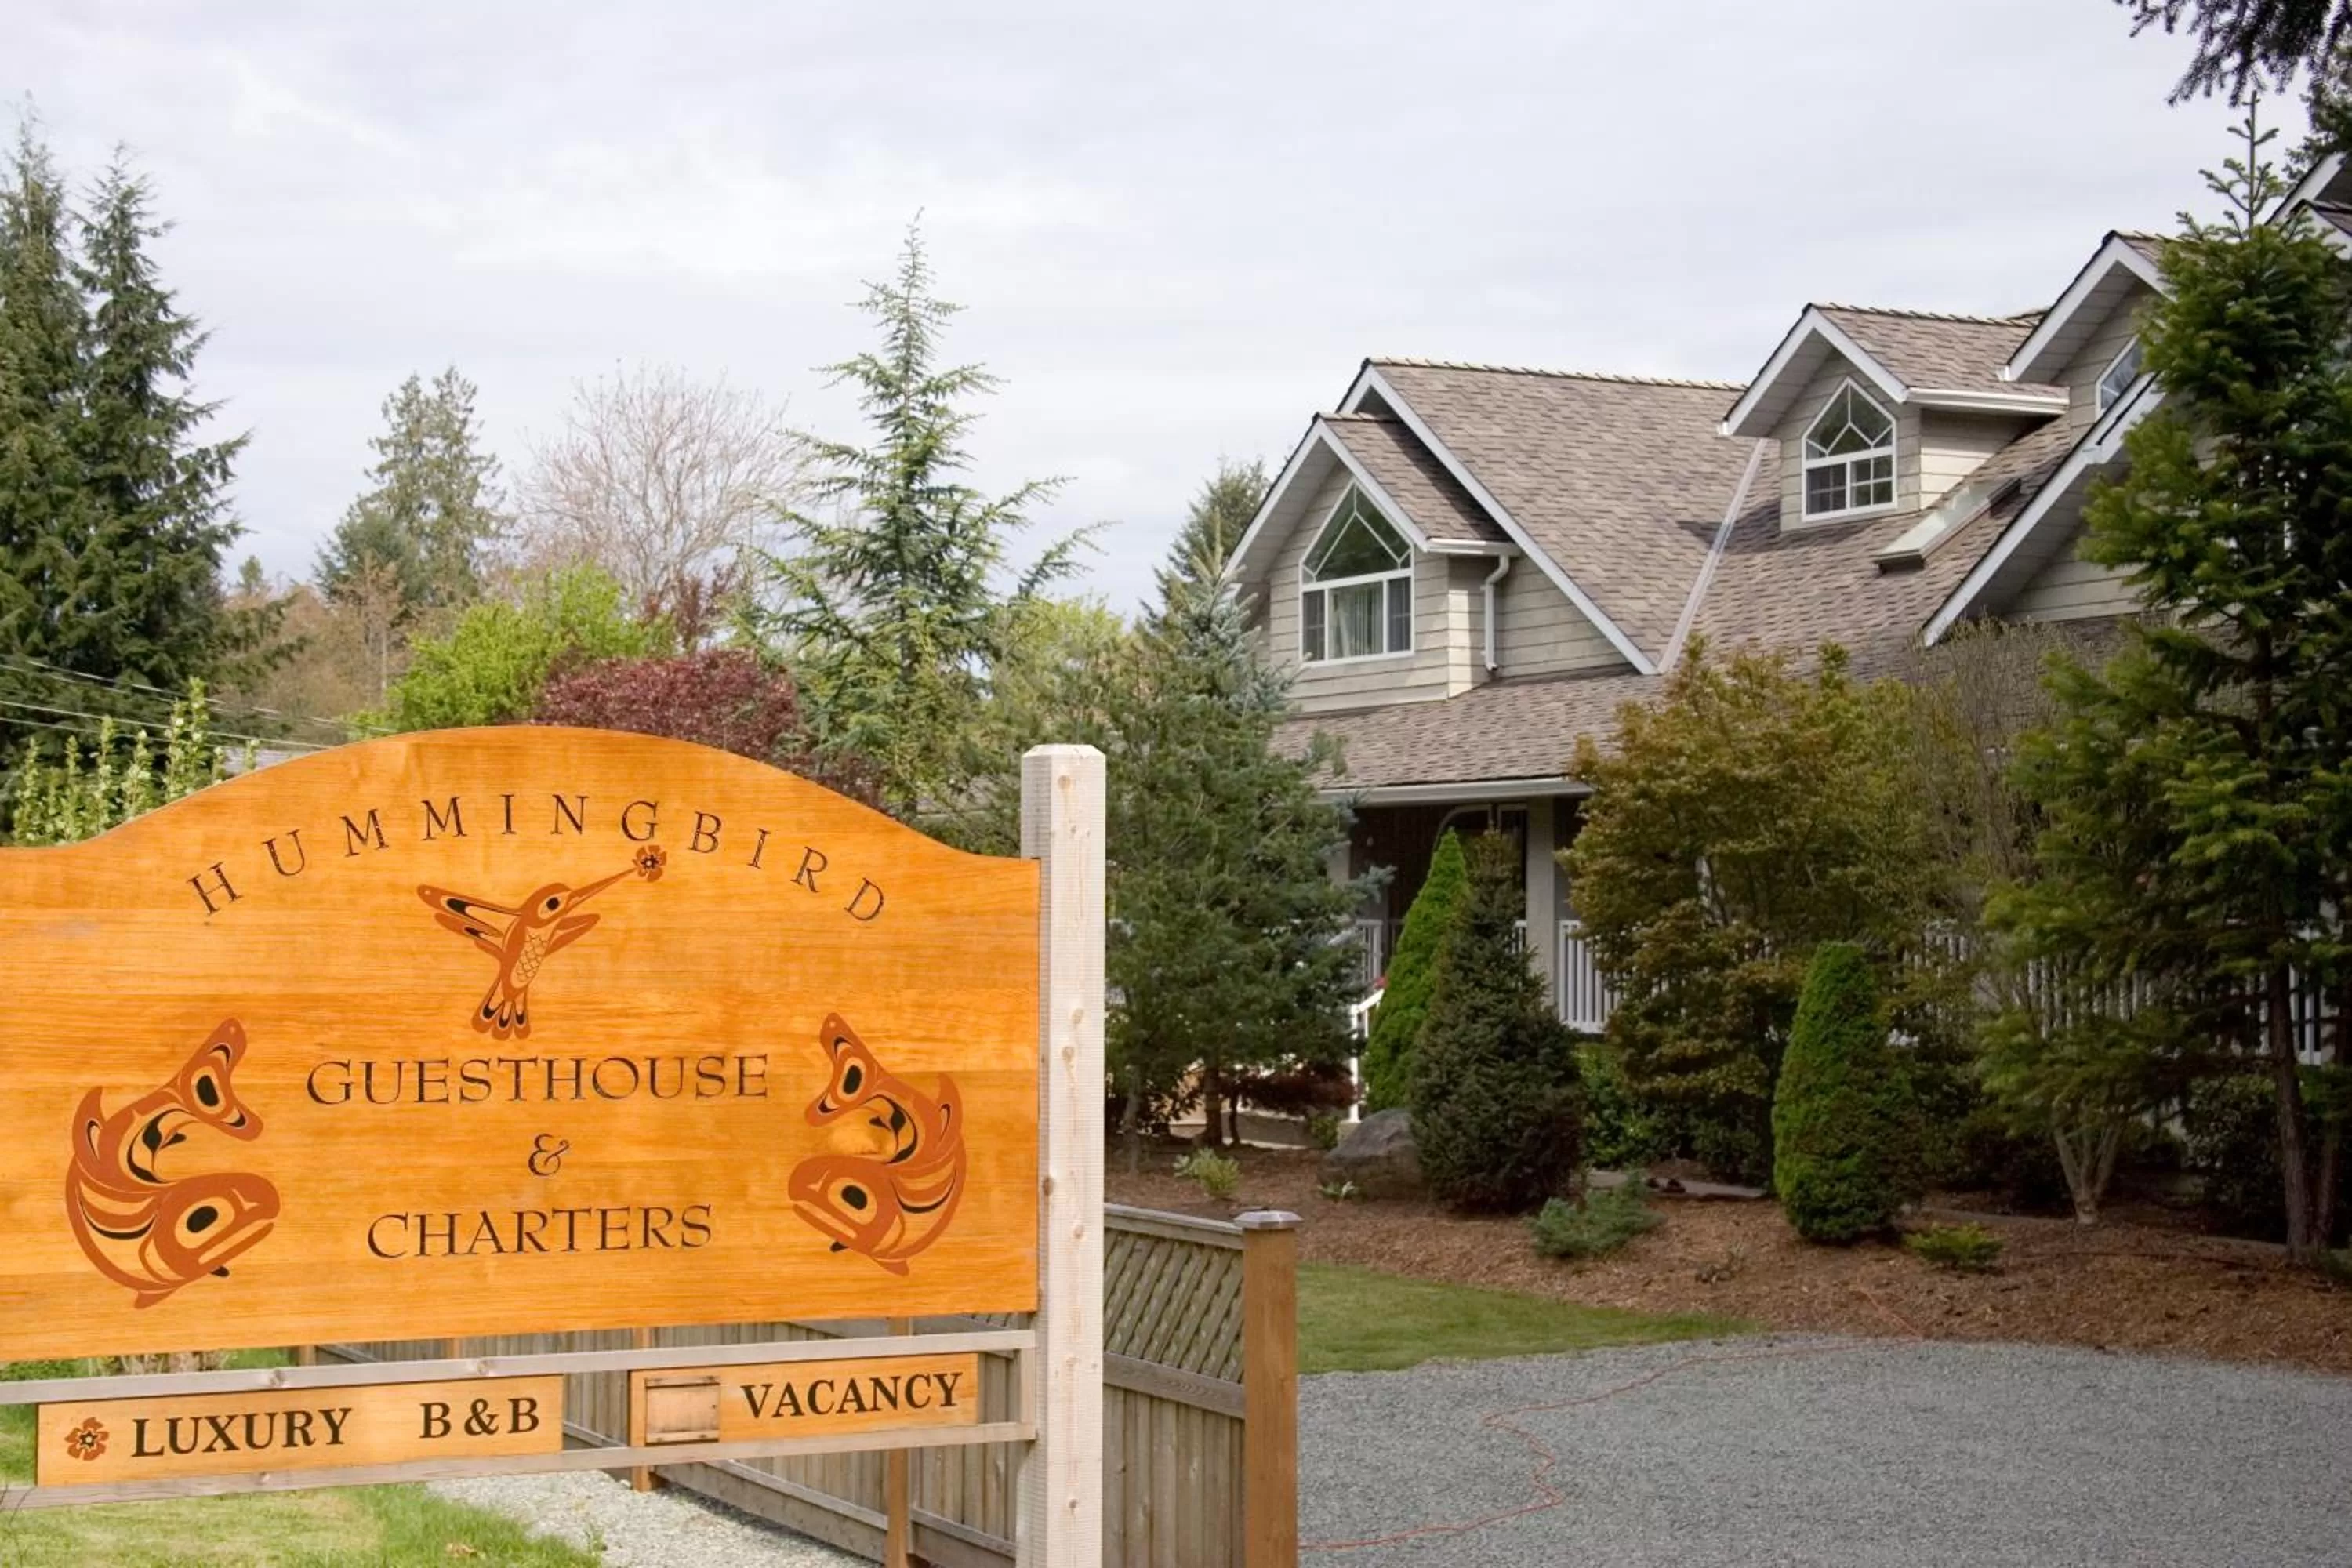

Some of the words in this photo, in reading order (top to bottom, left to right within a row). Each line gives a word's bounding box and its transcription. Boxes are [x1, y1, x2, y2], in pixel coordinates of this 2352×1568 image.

[187, 793, 886, 921] HUMMINGBIRD
[306, 1053, 769, 1106] GUESTHOUSE
[528, 1133, 569, 1177] &
[367, 1204, 713, 1259] CHARTERS
[741, 1372, 964, 1419] VACANCY
[131, 1407, 353, 1457] LUXURY
